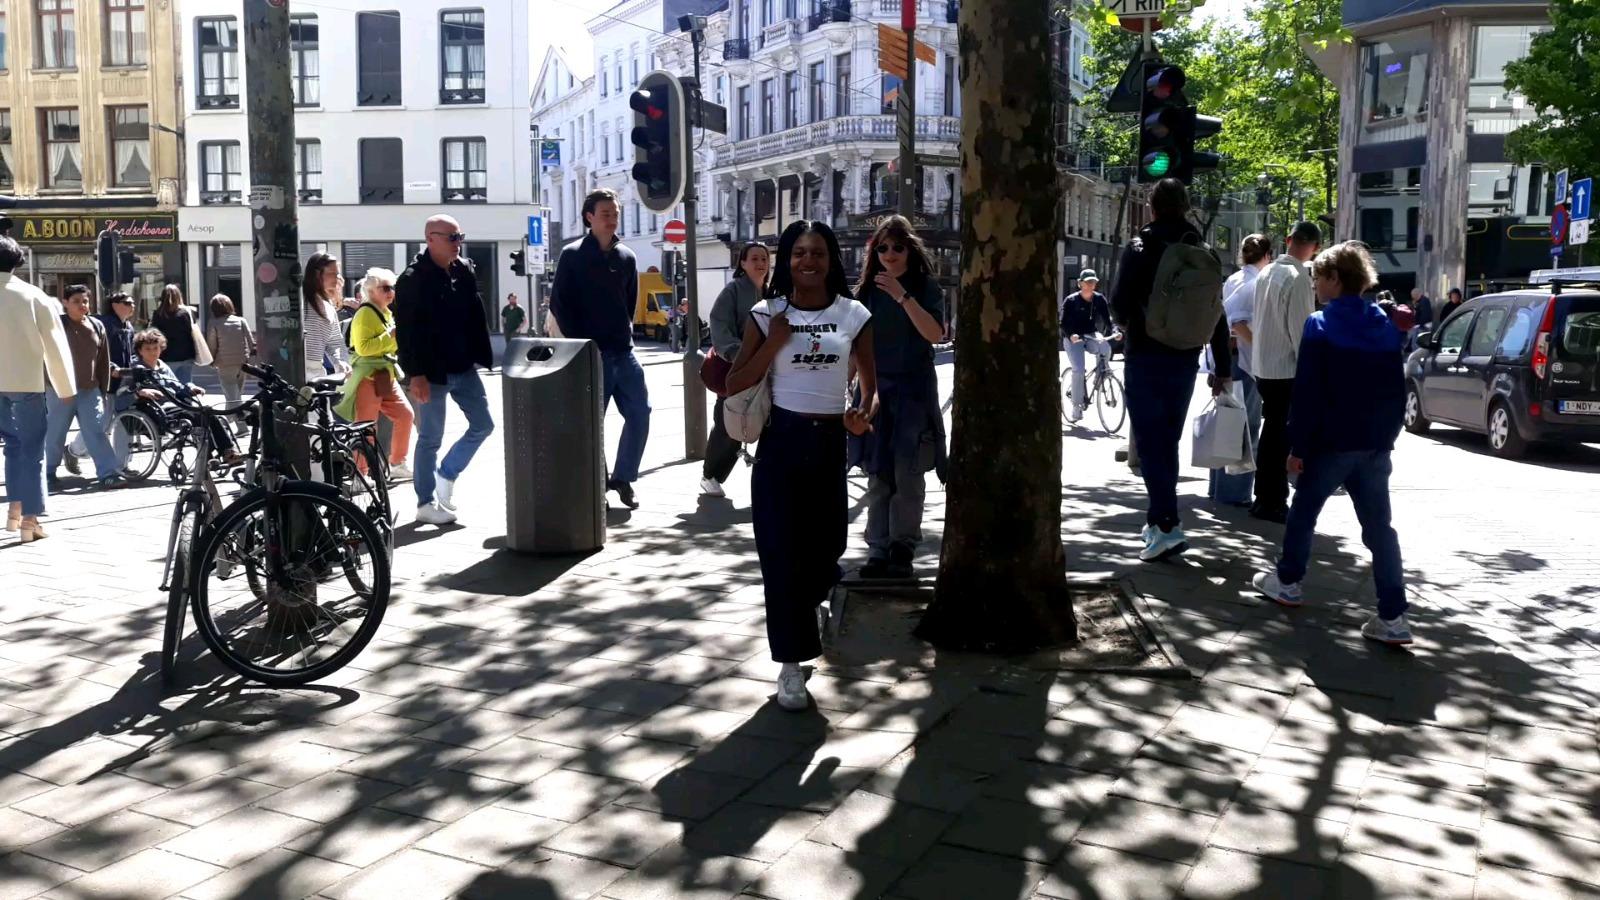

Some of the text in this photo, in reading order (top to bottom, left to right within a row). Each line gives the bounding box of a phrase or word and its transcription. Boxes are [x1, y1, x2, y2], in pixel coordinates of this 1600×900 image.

[23, 219, 172, 238] A.BOON Hndschoenen
[790, 323, 837, 333] MICKEY
[1566, 402, 1600, 411] 1-NDY-
